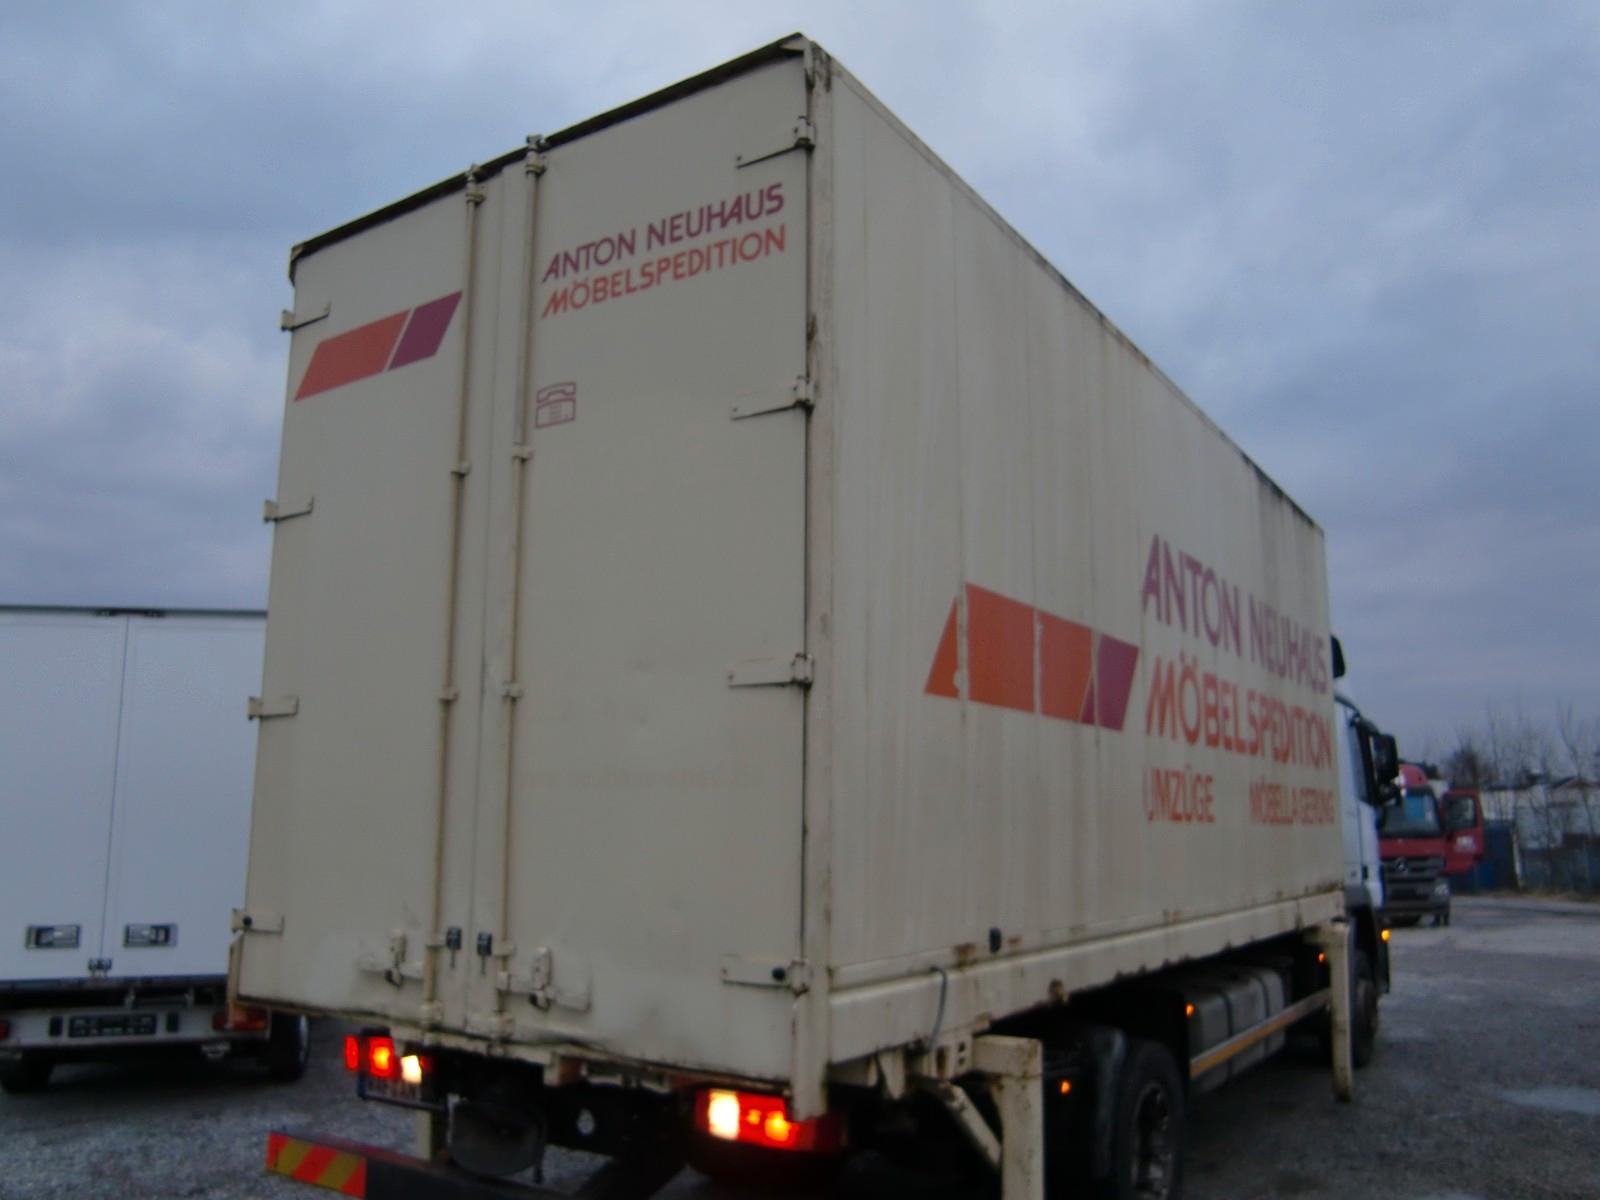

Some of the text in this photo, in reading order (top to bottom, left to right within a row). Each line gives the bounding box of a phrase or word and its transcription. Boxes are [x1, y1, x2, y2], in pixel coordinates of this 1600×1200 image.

[541, 182, 785, 283] ANTON NEUHAUS
[541, 224, 786, 319] MÖBELSPEDITION
[1142, 533, 1328, 694] ANTON NEUHAUS
[1146, 649, 1332, 769] MÖBELSPEDITION
